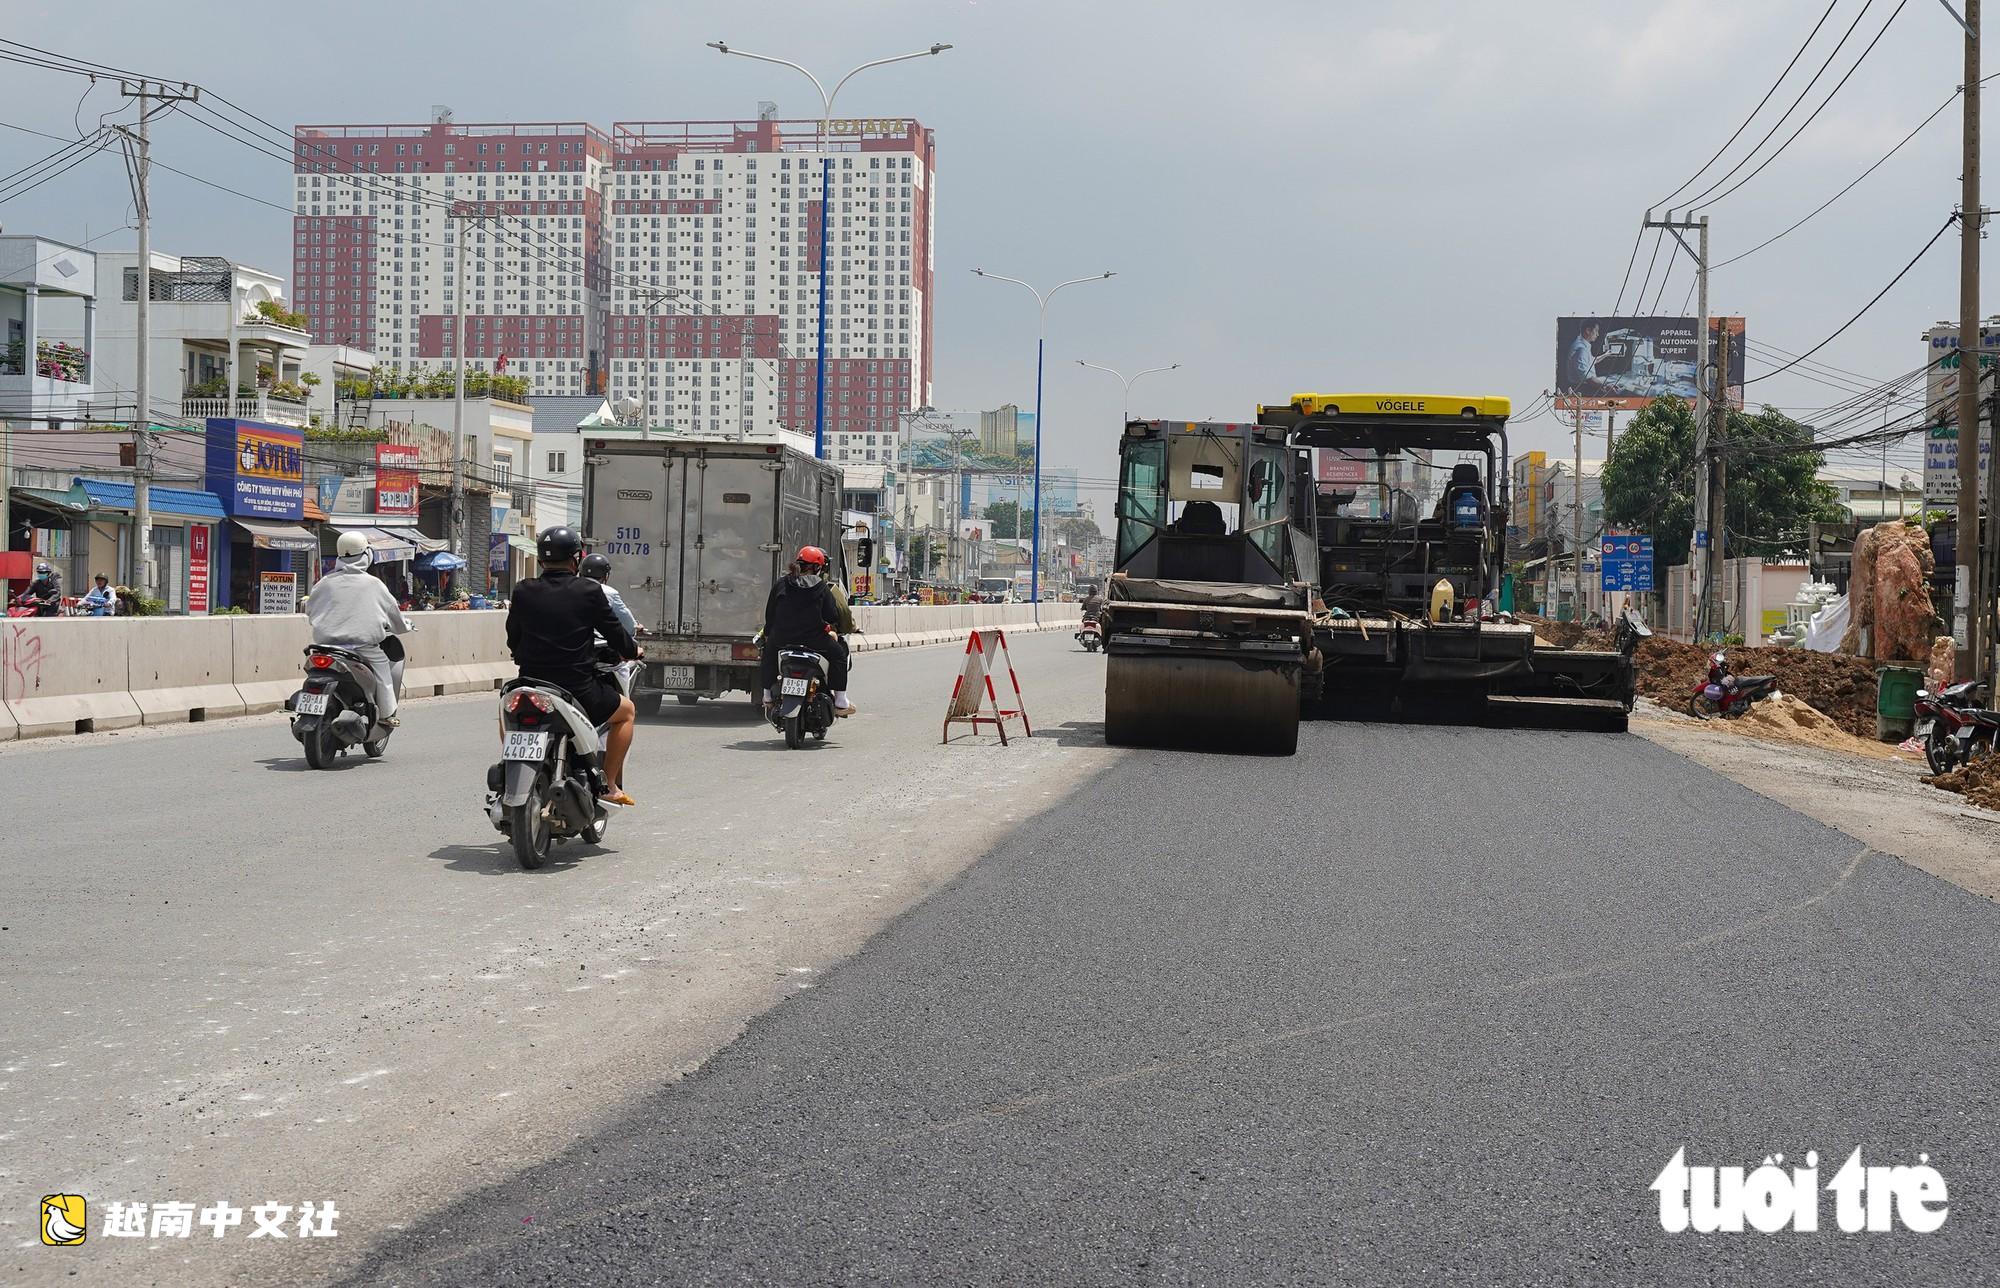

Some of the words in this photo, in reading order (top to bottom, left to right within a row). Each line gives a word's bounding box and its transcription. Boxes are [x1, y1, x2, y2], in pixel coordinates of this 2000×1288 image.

[1376, 398, 1425, 411] VÖGELE
[254, 441, 301, 473] JOTUN
[616, 527, 641, 540] 51D
[607, 542, 650, 555] 070.78
[671, 667, 688, 677] 51D
[510, 733, 539, 745] 60-B4
[504, 746, 542, 759] 440.20
